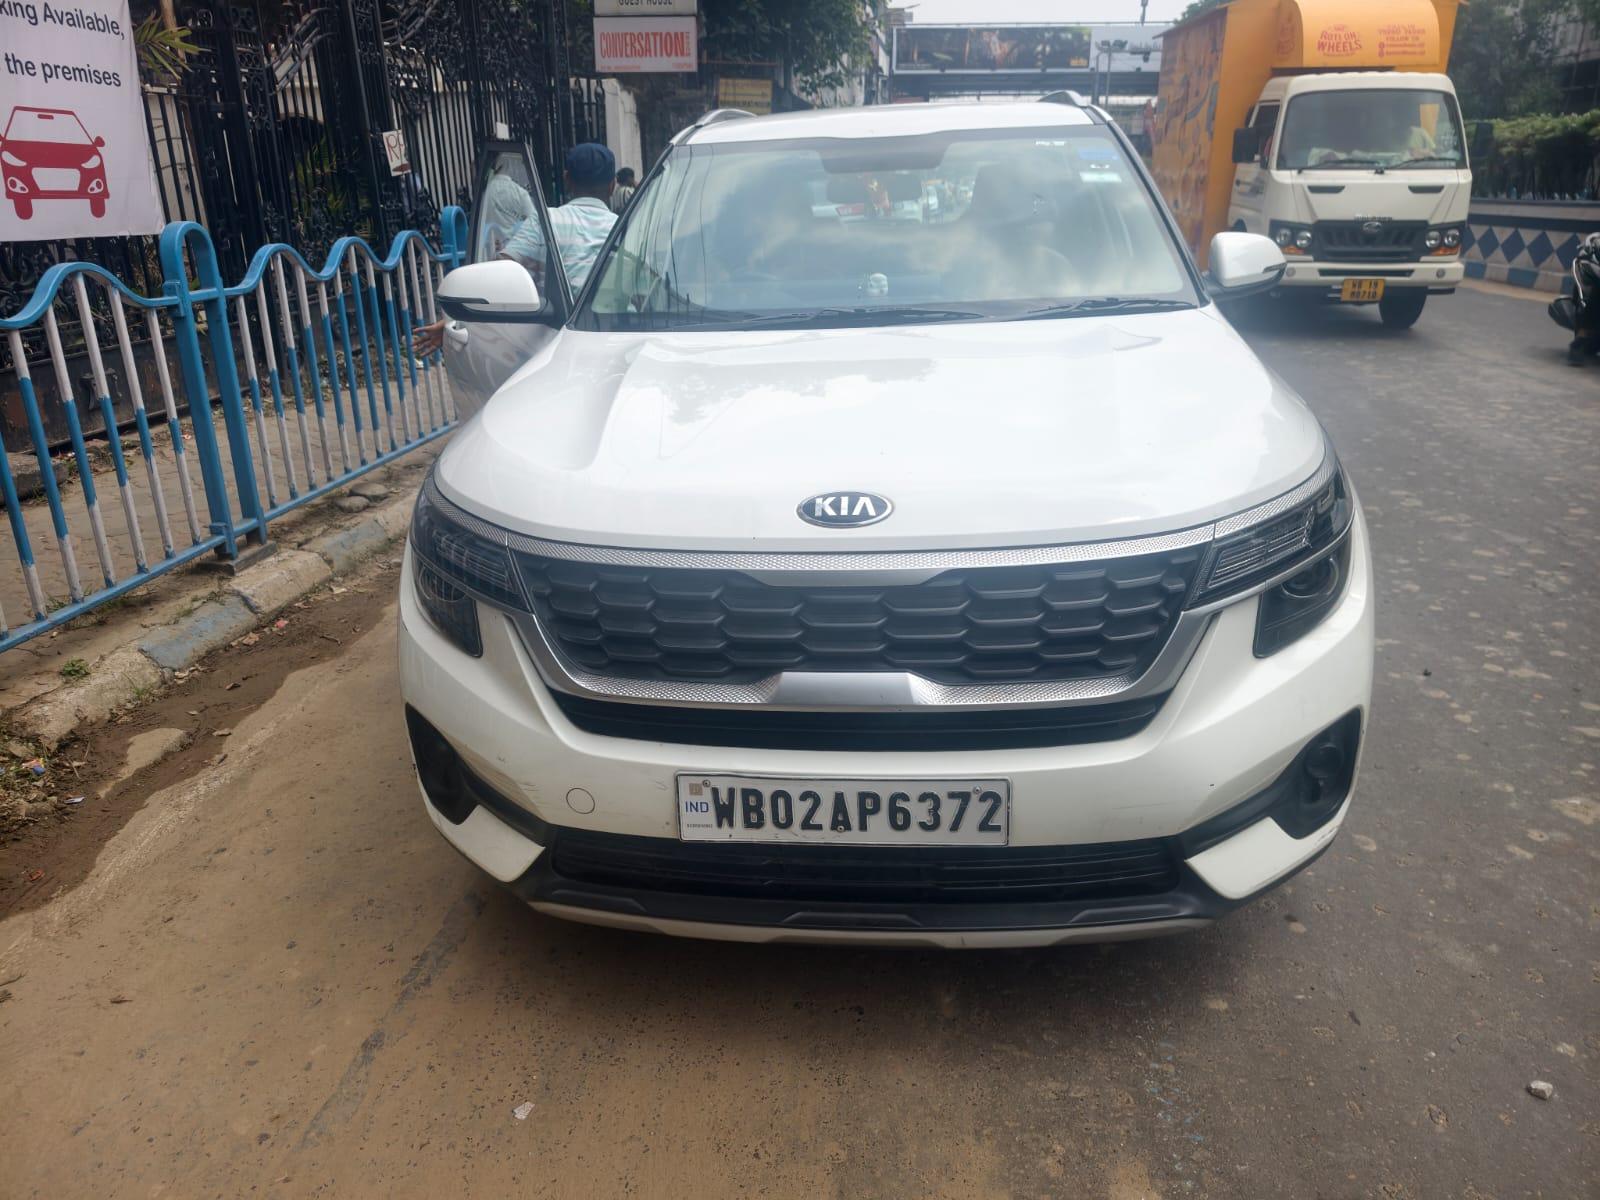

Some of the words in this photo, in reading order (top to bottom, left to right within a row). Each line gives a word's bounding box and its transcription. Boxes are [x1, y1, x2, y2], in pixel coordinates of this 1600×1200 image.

[43, 2, 125, 40] Available,
[599, 31, 685, 58] CONVERSATION
[1317, 40, 1362, 52] WHEELS
[5, 52, 37, 77] the
[41, 62, 122, 87] premises
[814, 496, 877, 517] KIA
[685, 800, 709, 813] IND
[711, 786, 1003, 833] WB02AP6372
